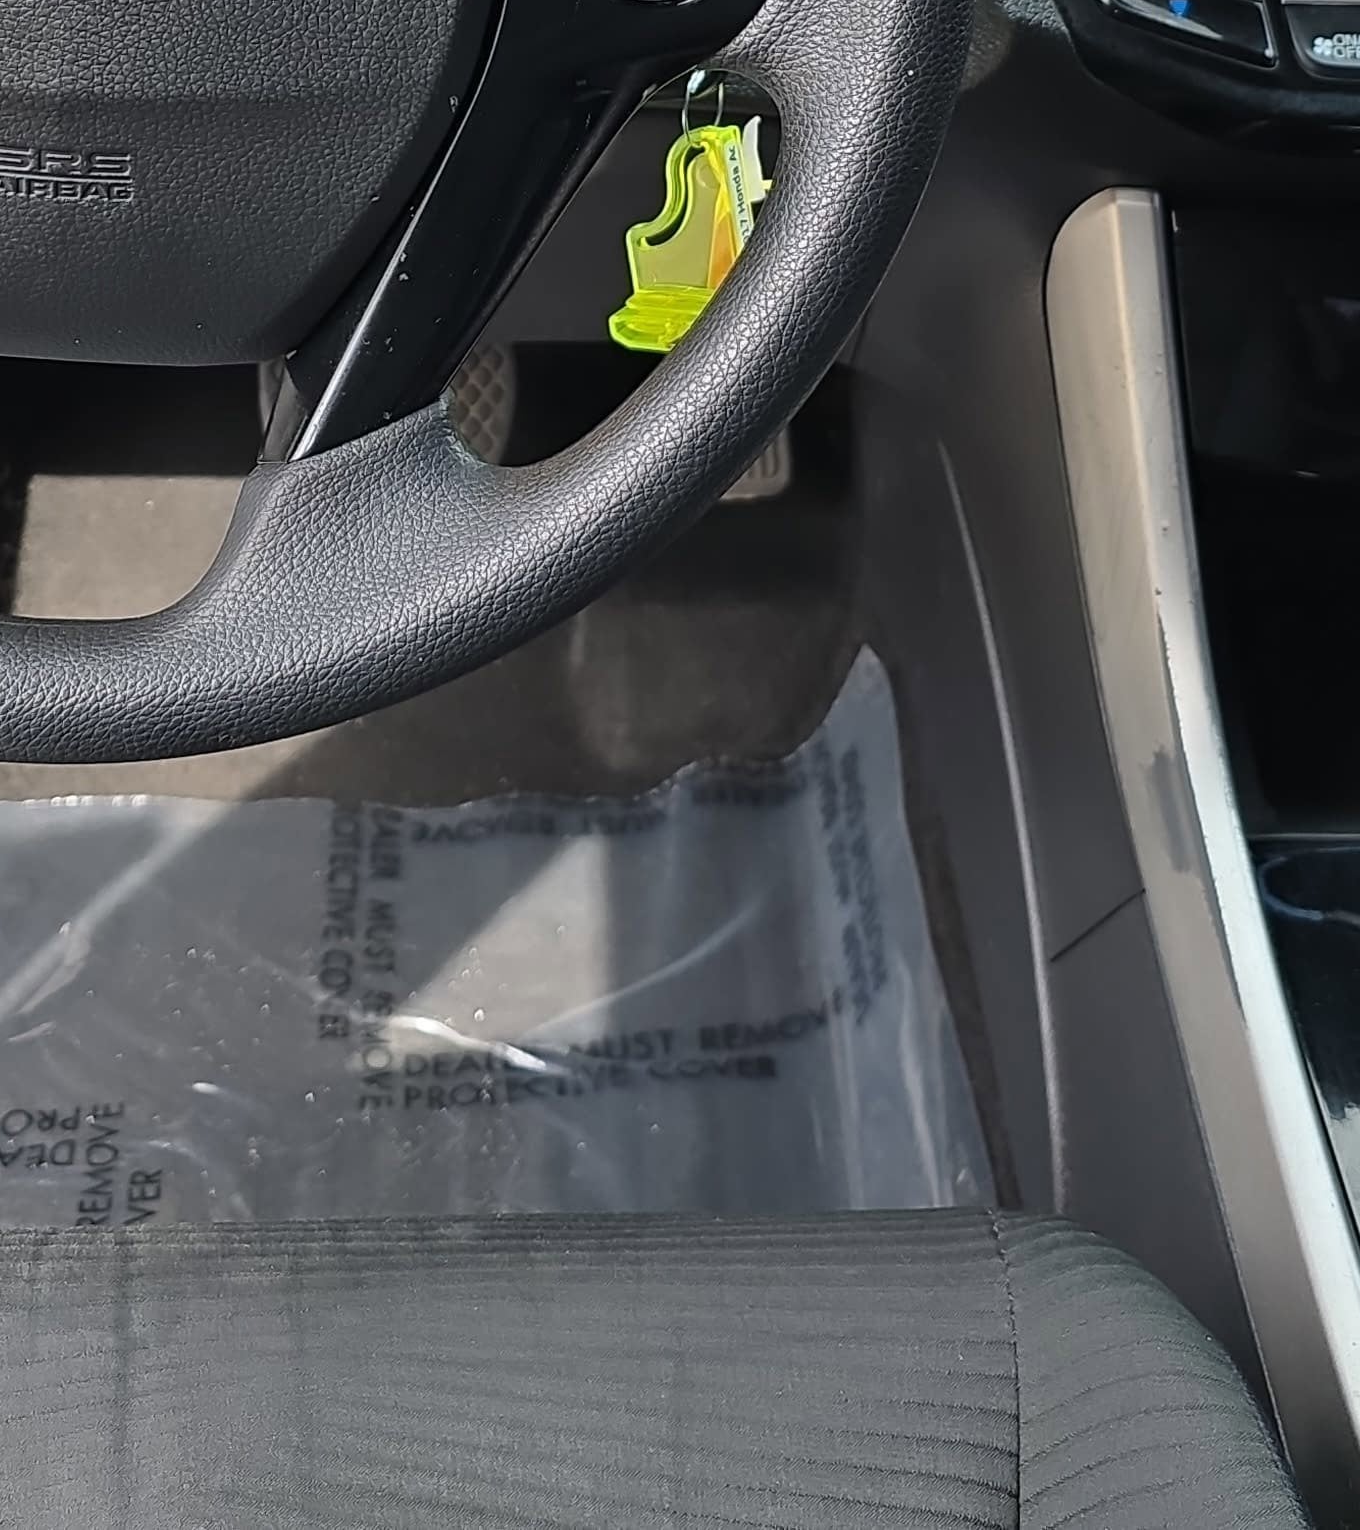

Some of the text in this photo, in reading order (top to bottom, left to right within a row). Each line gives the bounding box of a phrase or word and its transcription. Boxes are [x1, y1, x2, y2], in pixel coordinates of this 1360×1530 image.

[731, 165, 746, 216] Honda
[324, 809, 361, 940] OTECTIVE
[363, 898, 397, 974] MUST
[74, 1102, 126, 1227] REMOVE
[122, 1169, 163, 1226] VER
